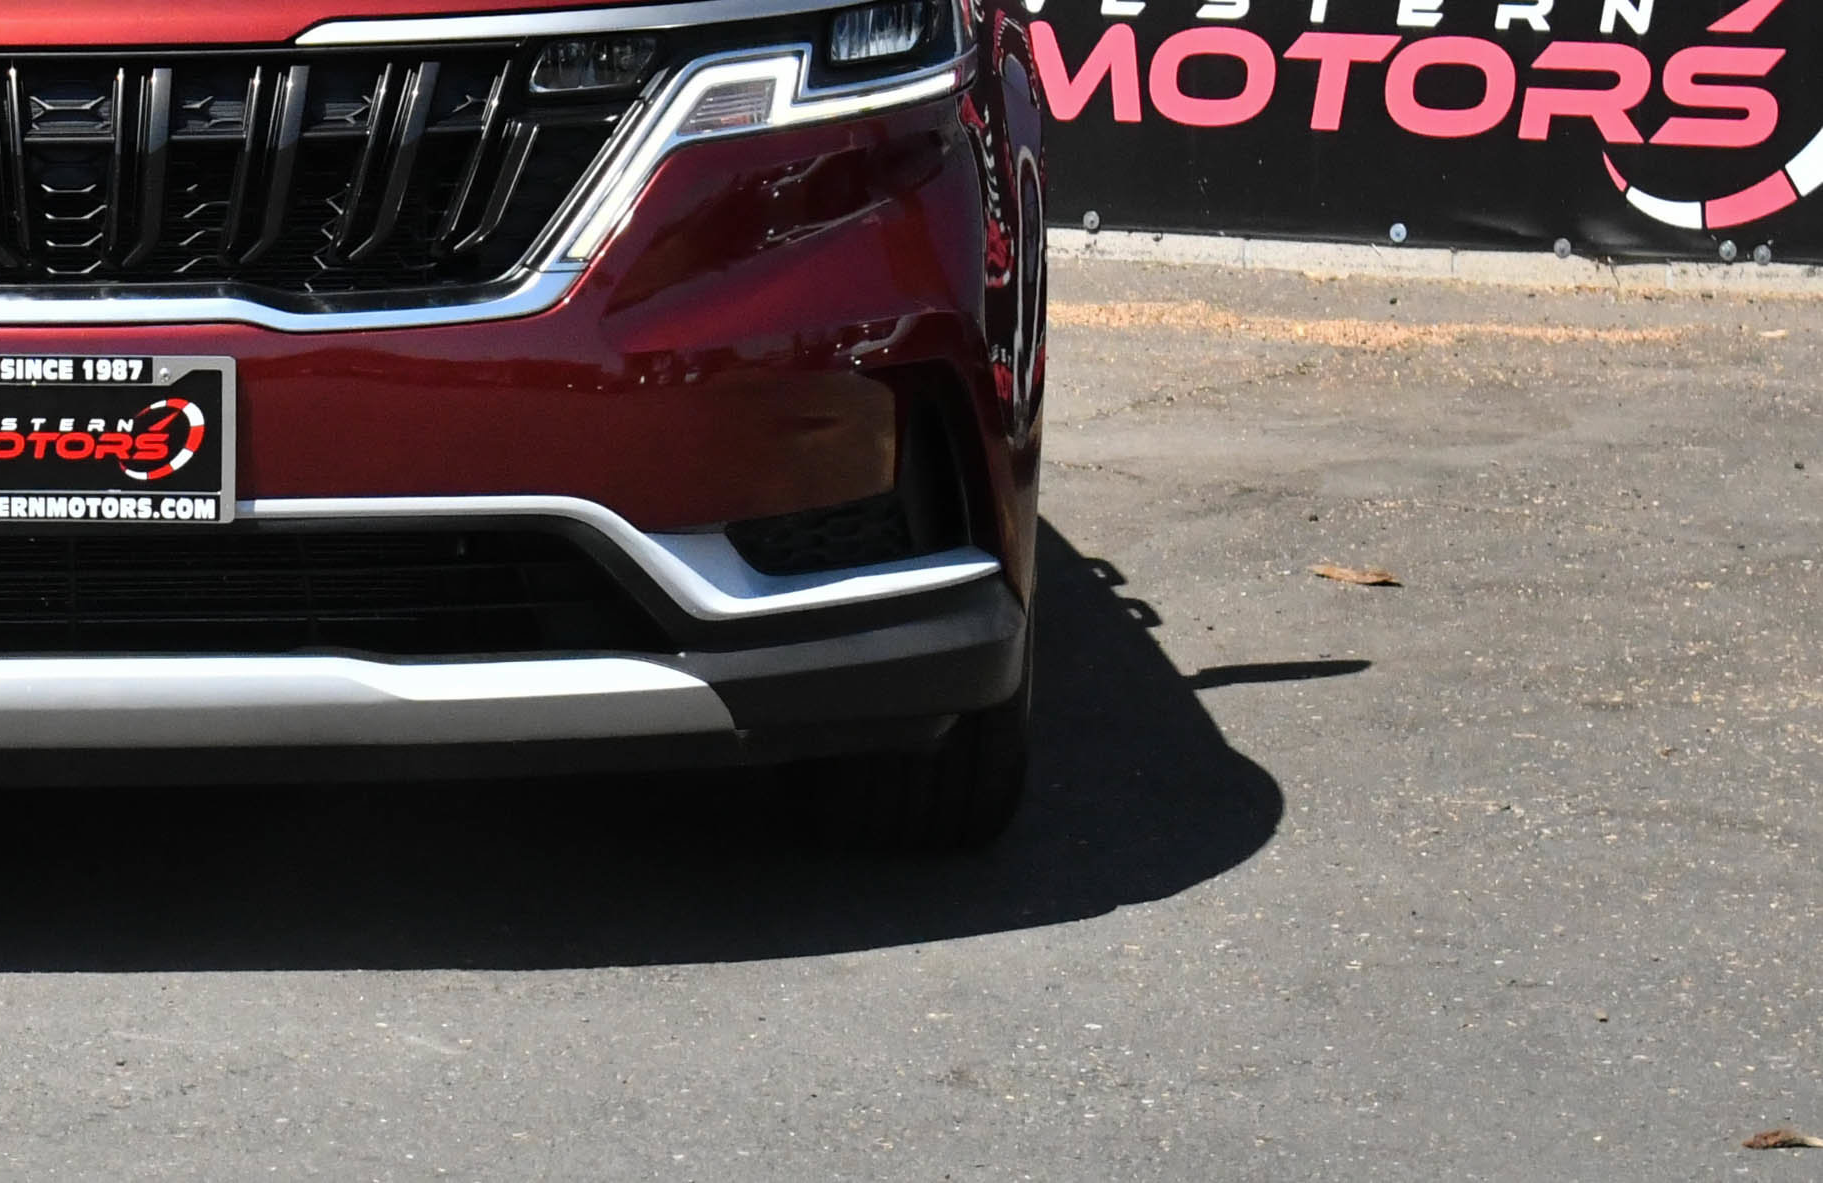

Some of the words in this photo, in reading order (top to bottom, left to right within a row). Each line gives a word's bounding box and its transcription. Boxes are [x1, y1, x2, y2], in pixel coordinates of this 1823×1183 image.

[1029, 20, 1786, 148] MOTORS
[0, 359, 73, 380] SINCE
[83, 359, 142, 381] 1987
